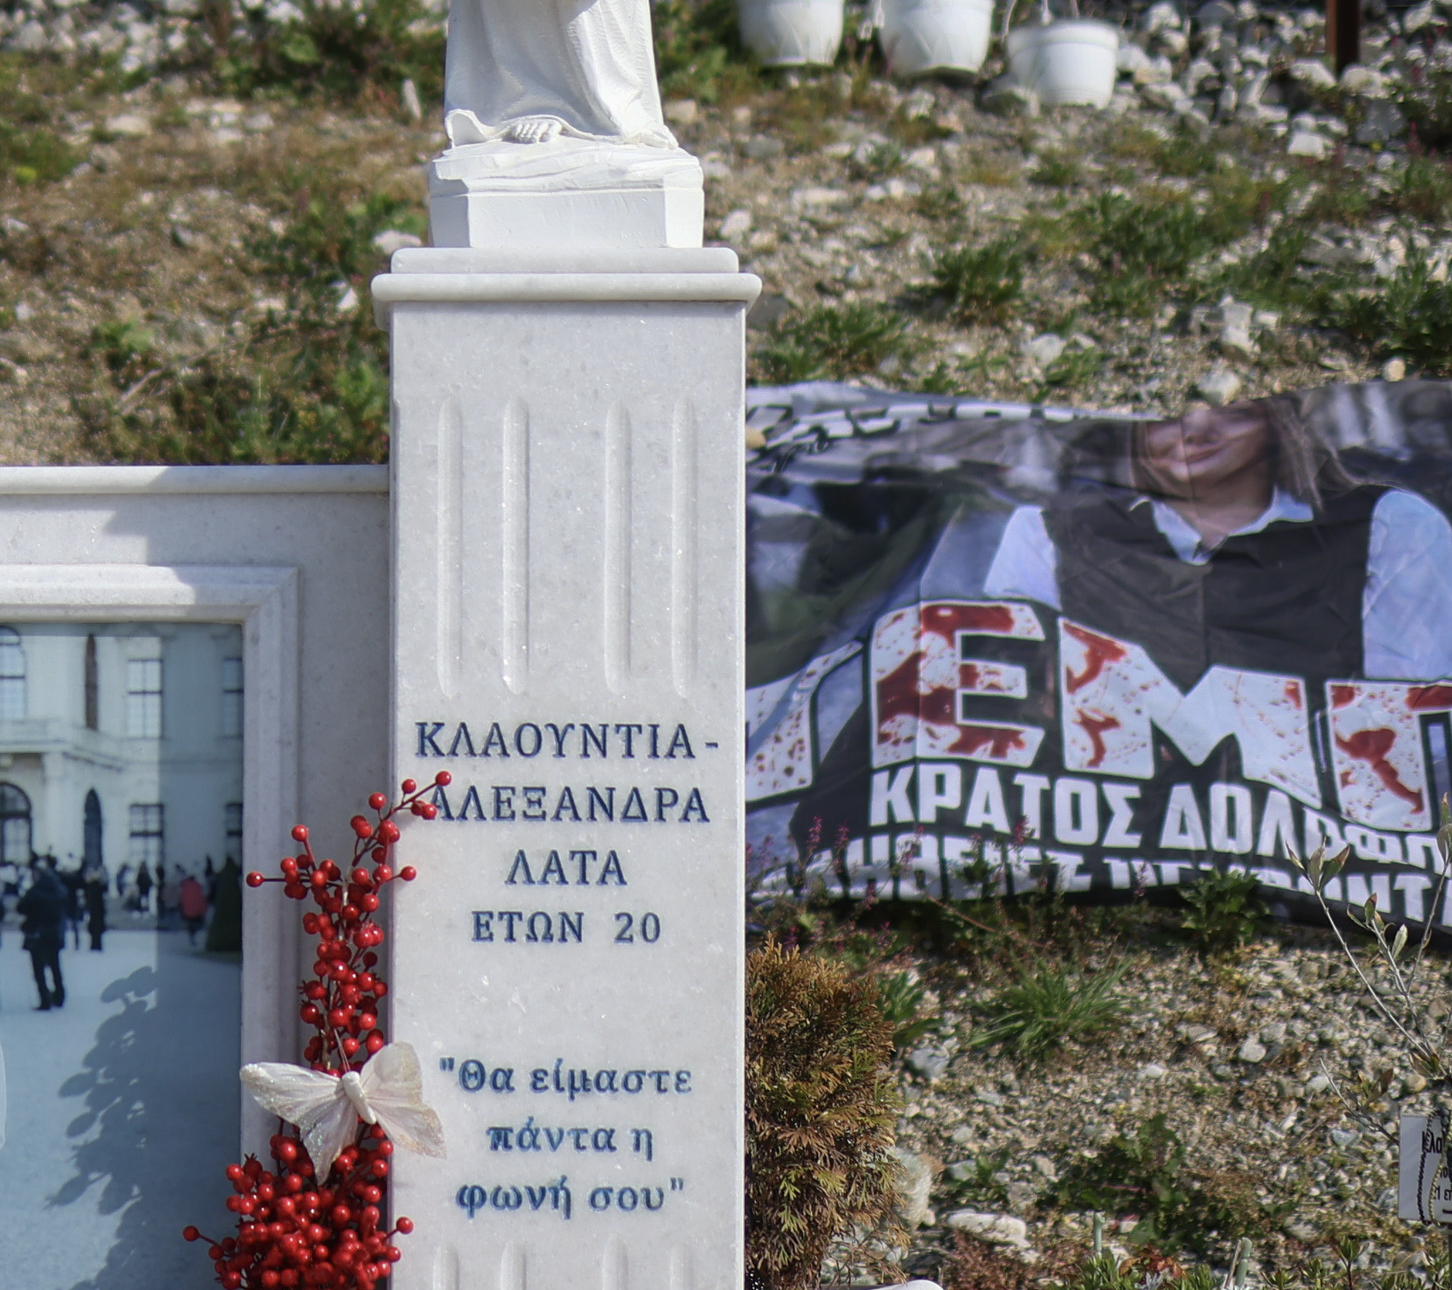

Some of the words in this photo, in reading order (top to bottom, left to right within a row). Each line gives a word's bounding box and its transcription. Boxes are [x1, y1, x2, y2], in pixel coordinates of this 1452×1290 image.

[432, 786, 710, 822] ΑΛΕΞΑΝΔΡΑ
[869, 762, 1143, 848] ΚΡΑΤΟΣ
[505, 850, 627, 885] ΛΑΤΑ
[472, 911, 584, 943] ΕΤΩΝ
[615, 912, 660, 943] 20
[440, 1057, 515, 1093] "Θα
[531, 1058, 693, 1100] είμαστε
[487, 1117, 616, 1152] πάντα
[632, 1127, 653, 1161] η
[456, 1175, 572, 1219] φωνή
[589, 1177, 684, 1211] σου"
